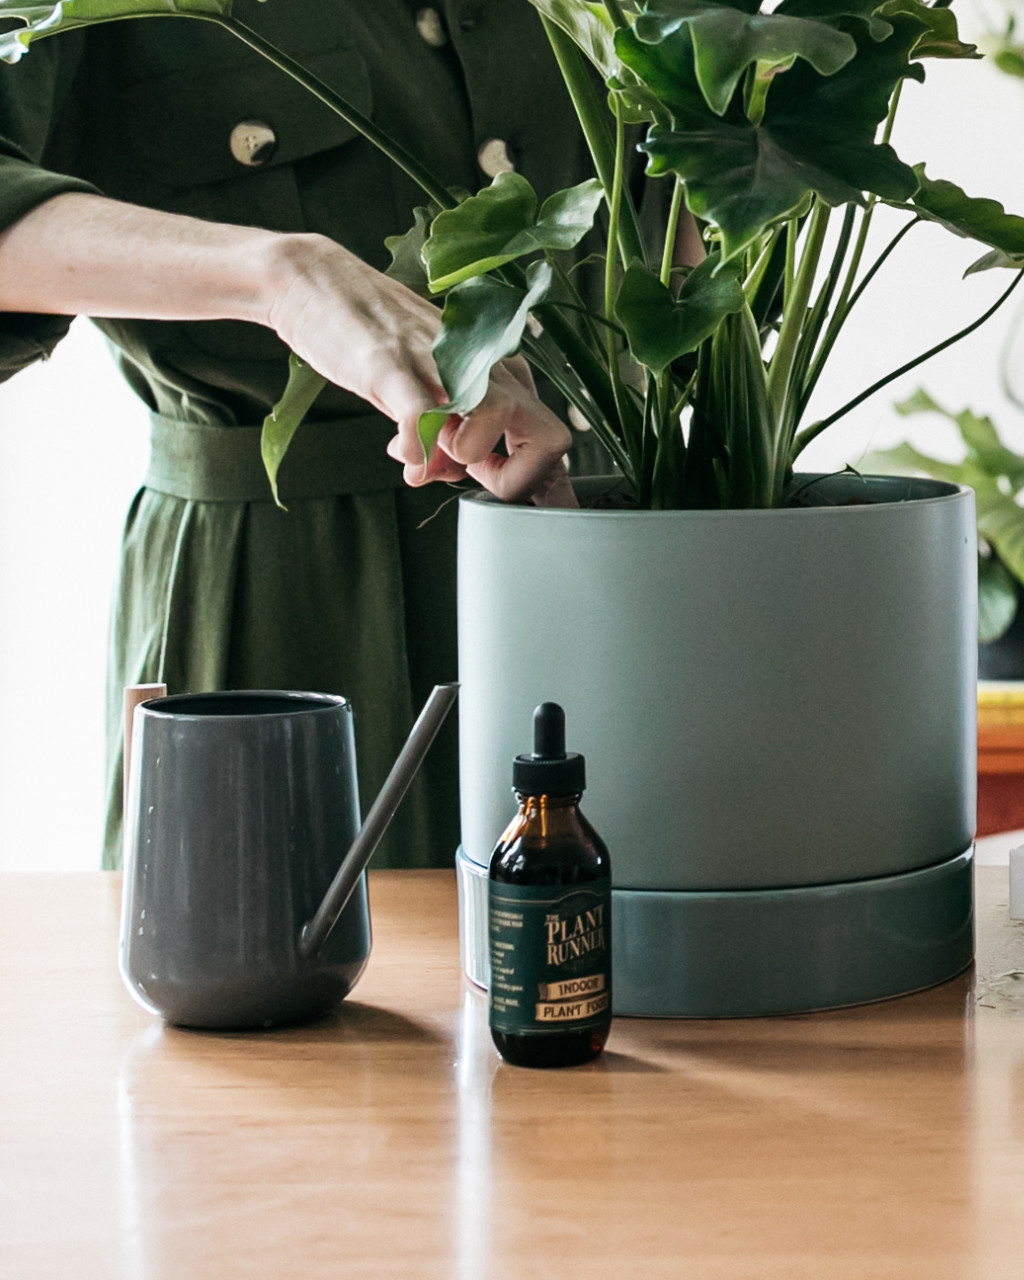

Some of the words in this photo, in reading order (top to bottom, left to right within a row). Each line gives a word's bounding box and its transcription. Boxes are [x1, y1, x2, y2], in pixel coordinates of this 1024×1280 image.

[544, 904, 604, 944] PLANT
[546, 927, 606, 966] RUNNER
[543, 1004, 582, 1018] PLANT
